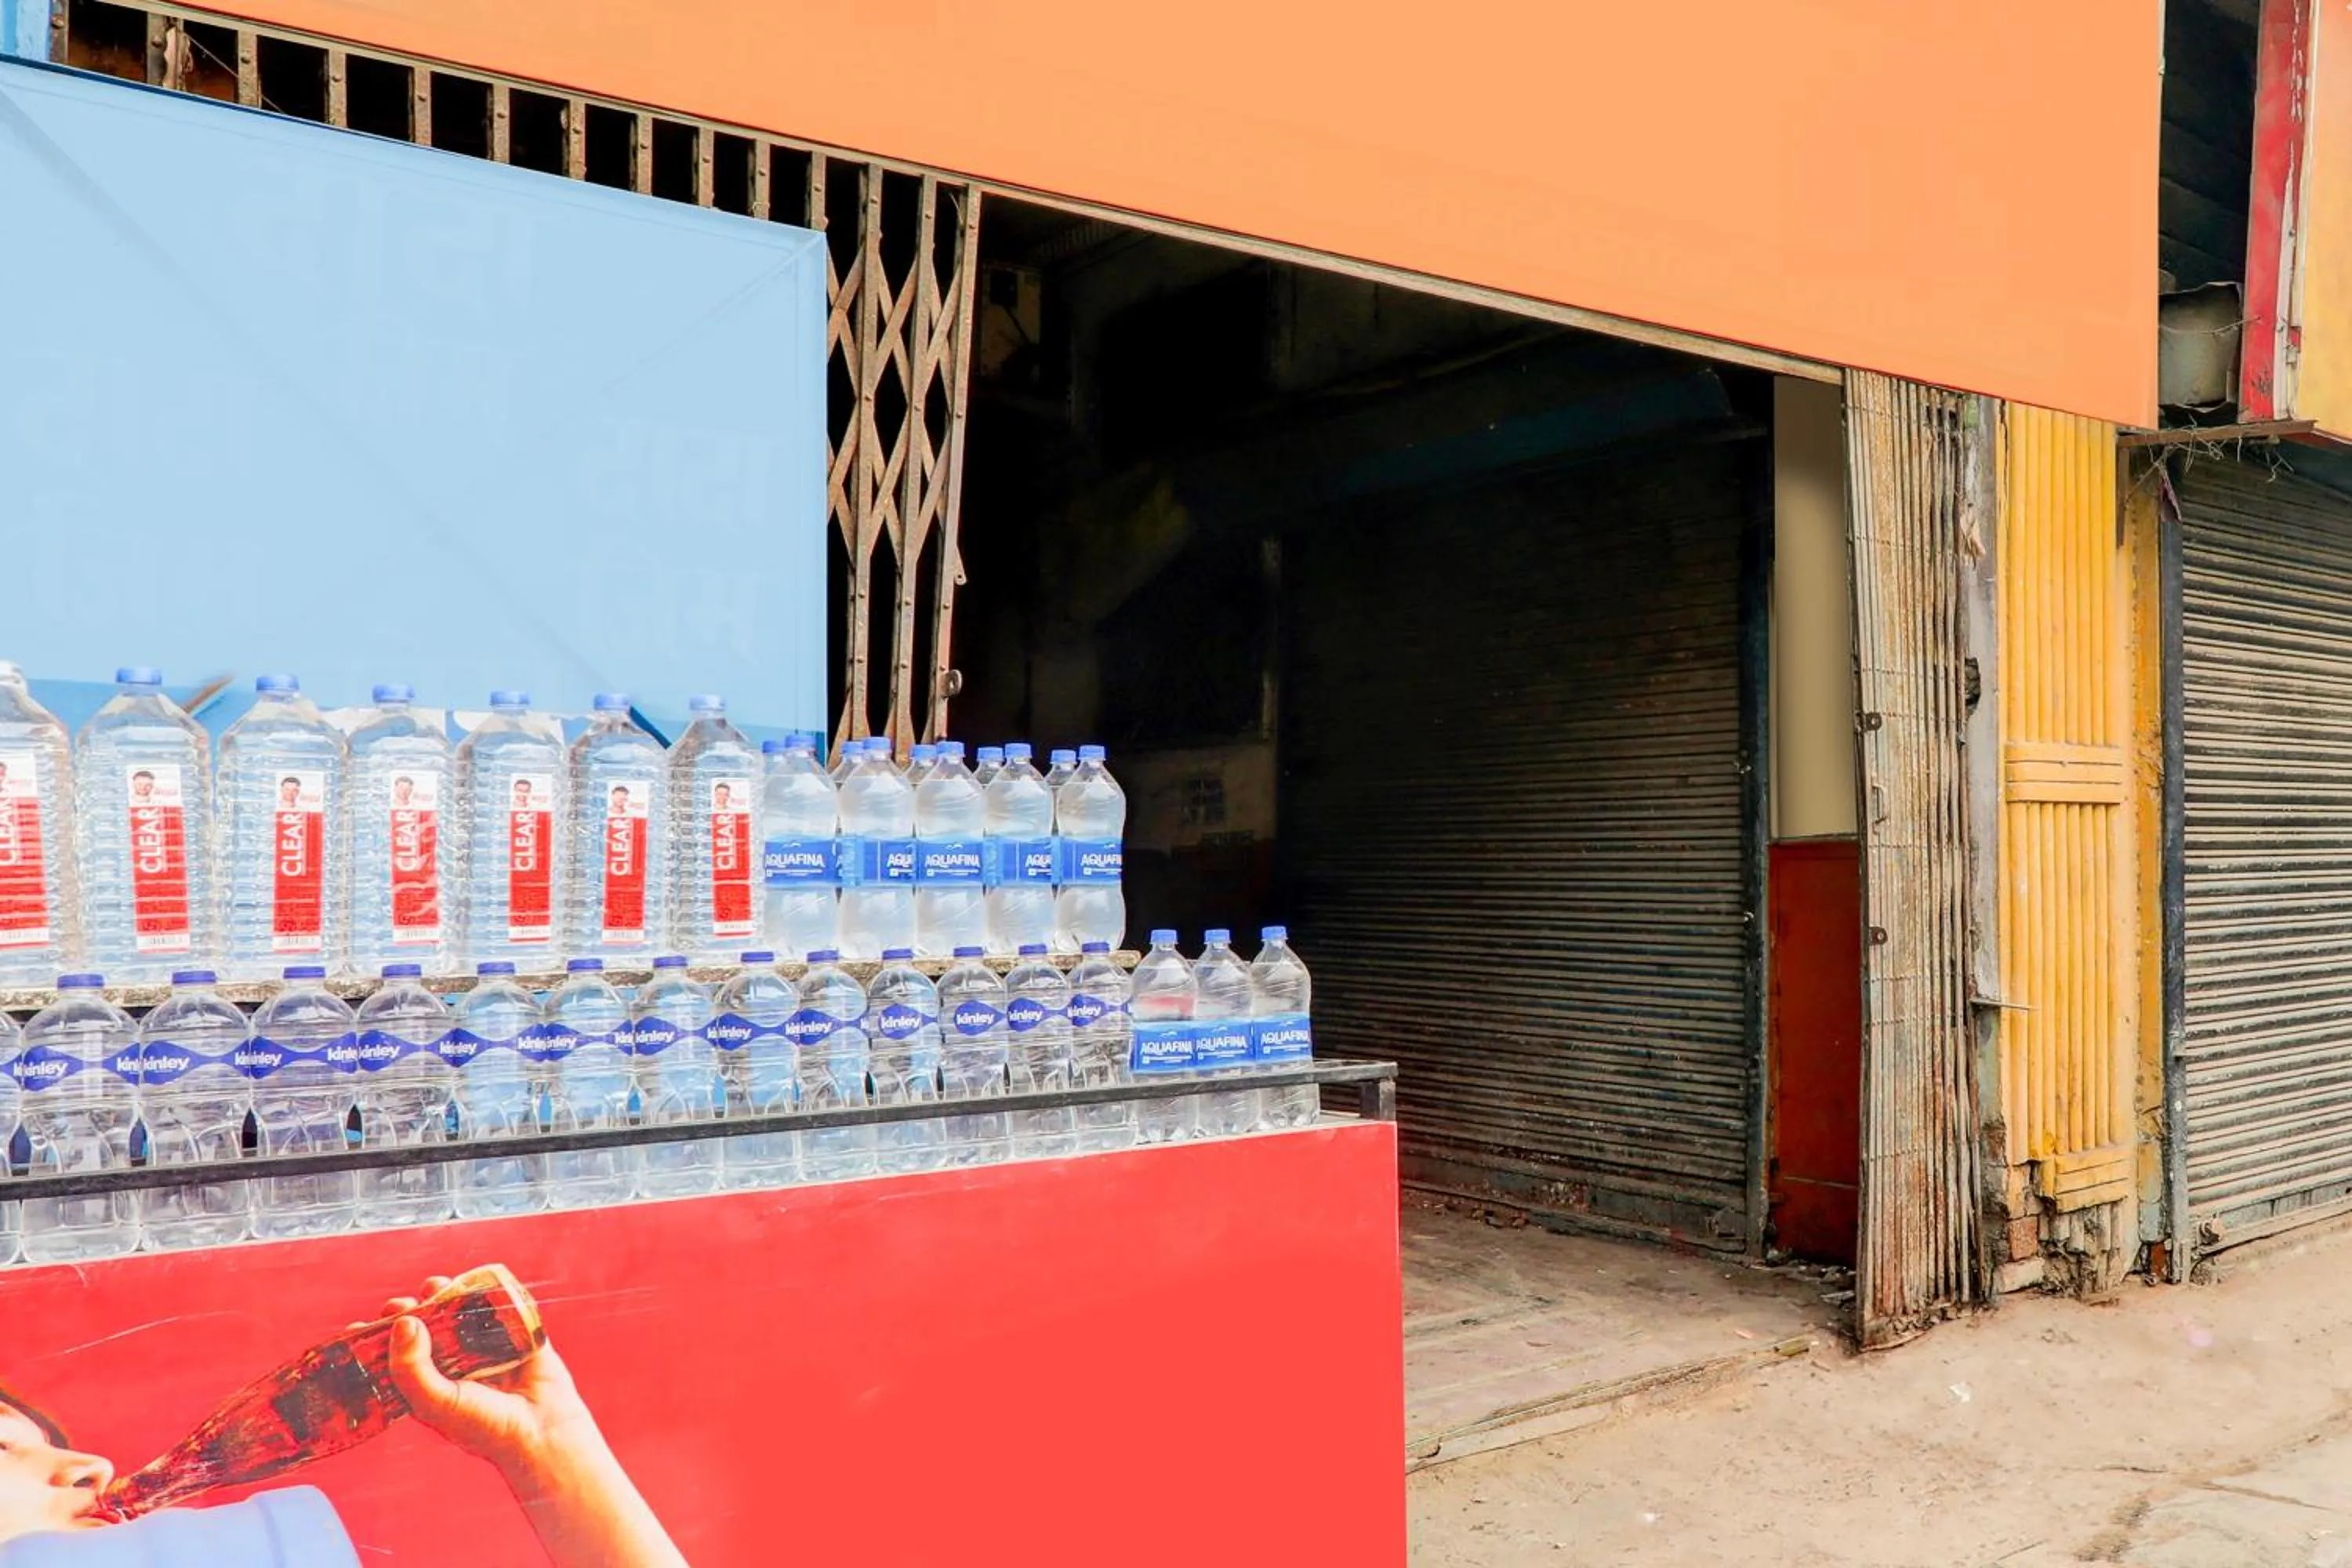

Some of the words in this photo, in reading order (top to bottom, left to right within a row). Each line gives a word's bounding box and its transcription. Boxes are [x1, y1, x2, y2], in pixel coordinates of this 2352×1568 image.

[138, 808, 162, 873] CLEAR
[281, 812, 303, 877] CLEAR
[396, 811, 418, 871] CLEAR
[514, 811, 535, 871] CLEAR
[610, 818, 632, 877] CLEAR
[717, 815, 734, 870] CLEAR
[925, 854, 981, 868] AQUAFINA
[956, 1012, 994, 1025] kinley
[1008, 1010, 1043, 1022] kinley
[1067, 1004, 1102, 1018] kinley
[881, 1016, 920, 1029] kinley
[1140, 1040, 1192, 1056] AQUAFINA
[1196, 1035, 1248, 1051] AQUAFINA
